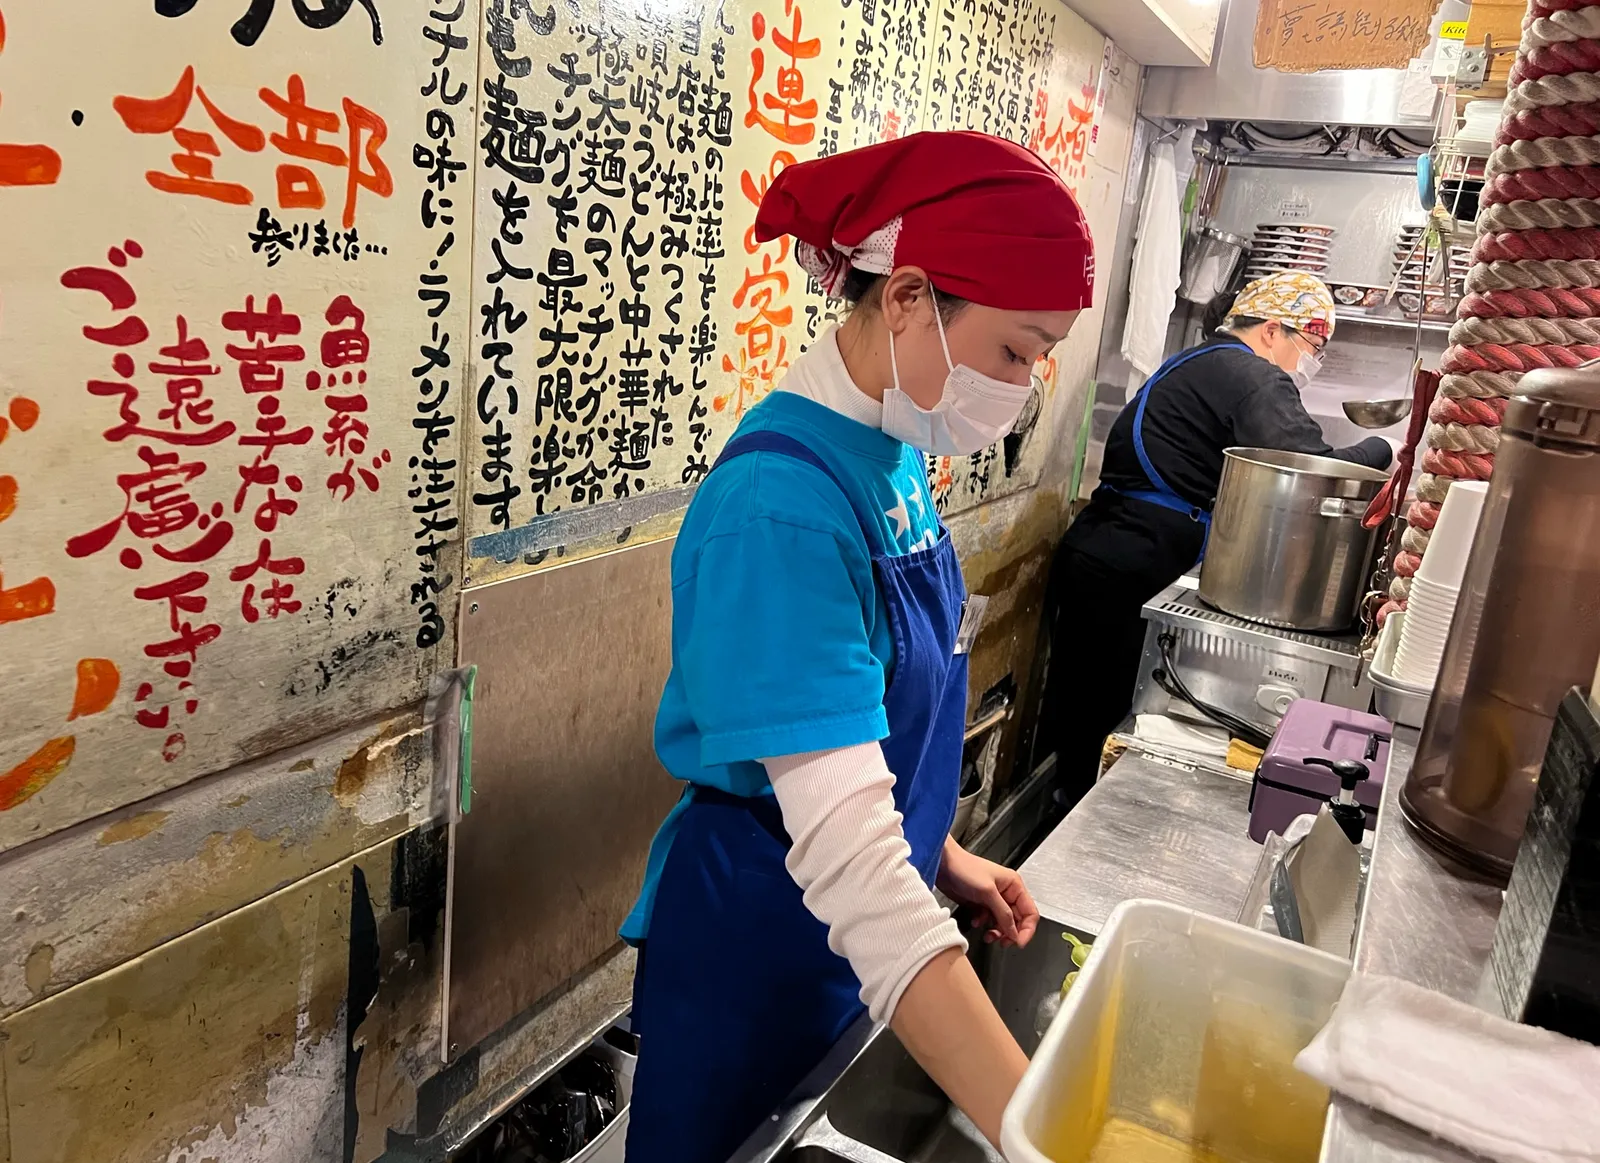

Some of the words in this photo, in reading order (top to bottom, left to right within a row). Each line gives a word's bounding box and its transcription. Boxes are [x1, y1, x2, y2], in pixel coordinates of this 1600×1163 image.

[112, 65, 393, 228] 全部
[221, 293, 312, 624] 苦手な人は
[307, 294, 391, 502] 魚系が
